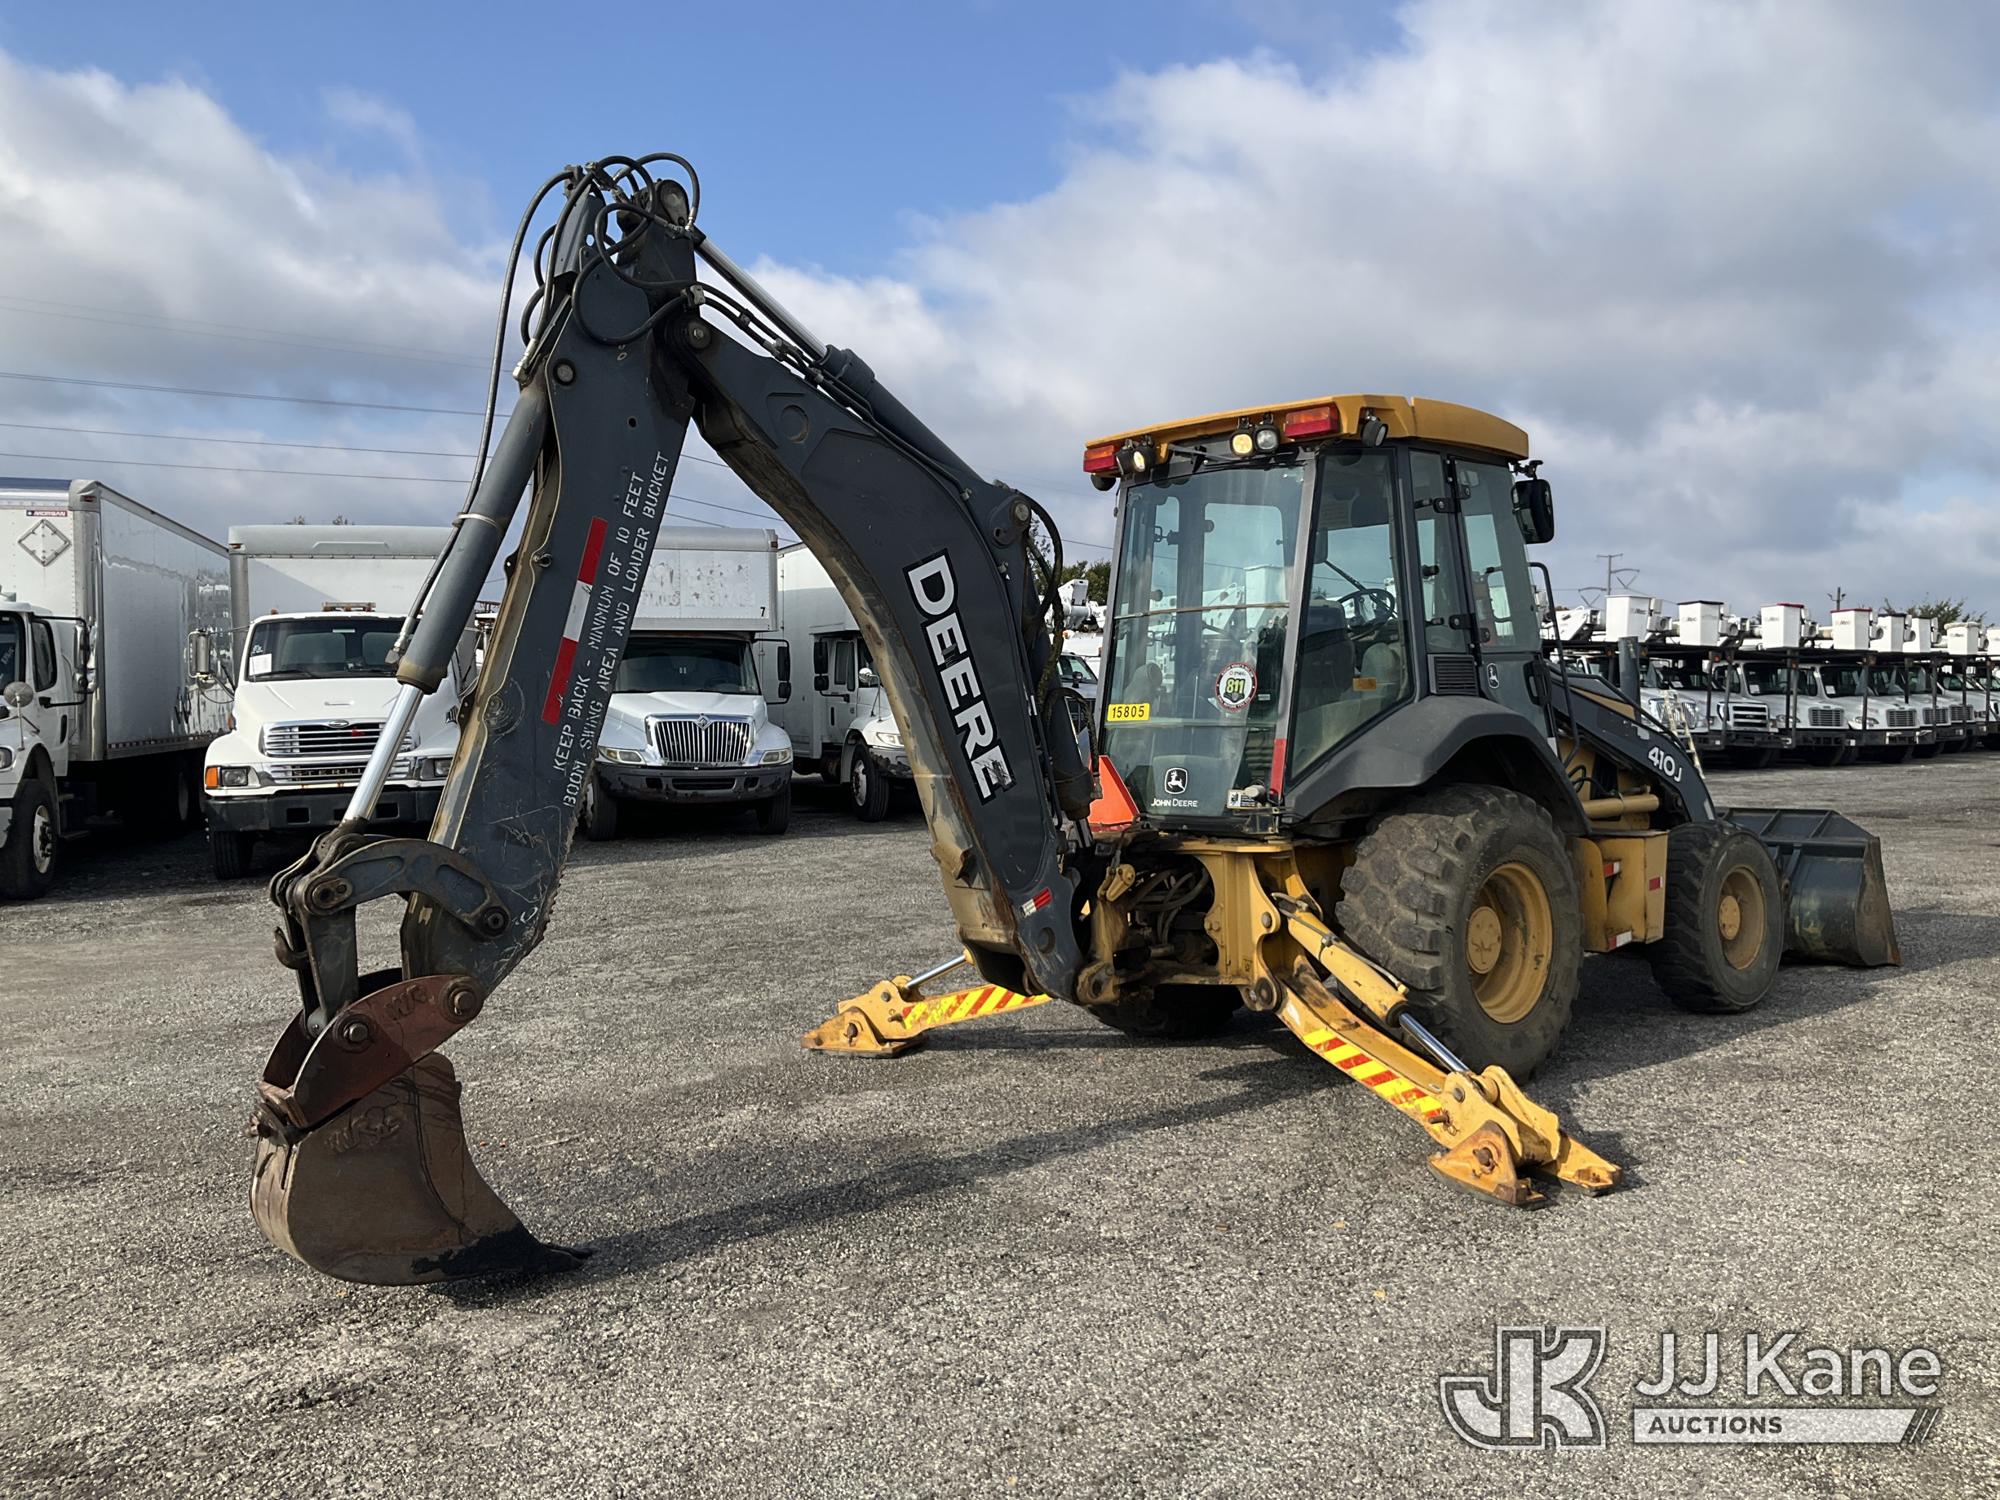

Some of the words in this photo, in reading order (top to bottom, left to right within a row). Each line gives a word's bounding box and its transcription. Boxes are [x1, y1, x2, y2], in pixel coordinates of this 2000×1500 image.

[553, 724, 575, 771] KEEP
[568, 674, 591, 719] BACK
[588, 585, 616, 650] MINIMUM
[607, 552, 623, 576] OF
[622, 471, 645, 518] FEET
[760, 606, 766, 617] 7
[563, 760, 588, 808] BOOM
[580, 700, 603, 751] SWING
[596, 647, 619, 691] AREA
[611, 601, 631, 637] AND
[622, 527, 651, 593] LOADER
[642, 450, 670, 519] BUCKET
[907, 554, 1013, 800] DEERE
[1226, 678, 1246, 694] 811
[1112, 705, 1145, 719] 15805
[1648, 746, 1683, 782] 410J
[1151, 798, 1172, 807] JOHN
[1172, 798, 1199, 808] DEERE
